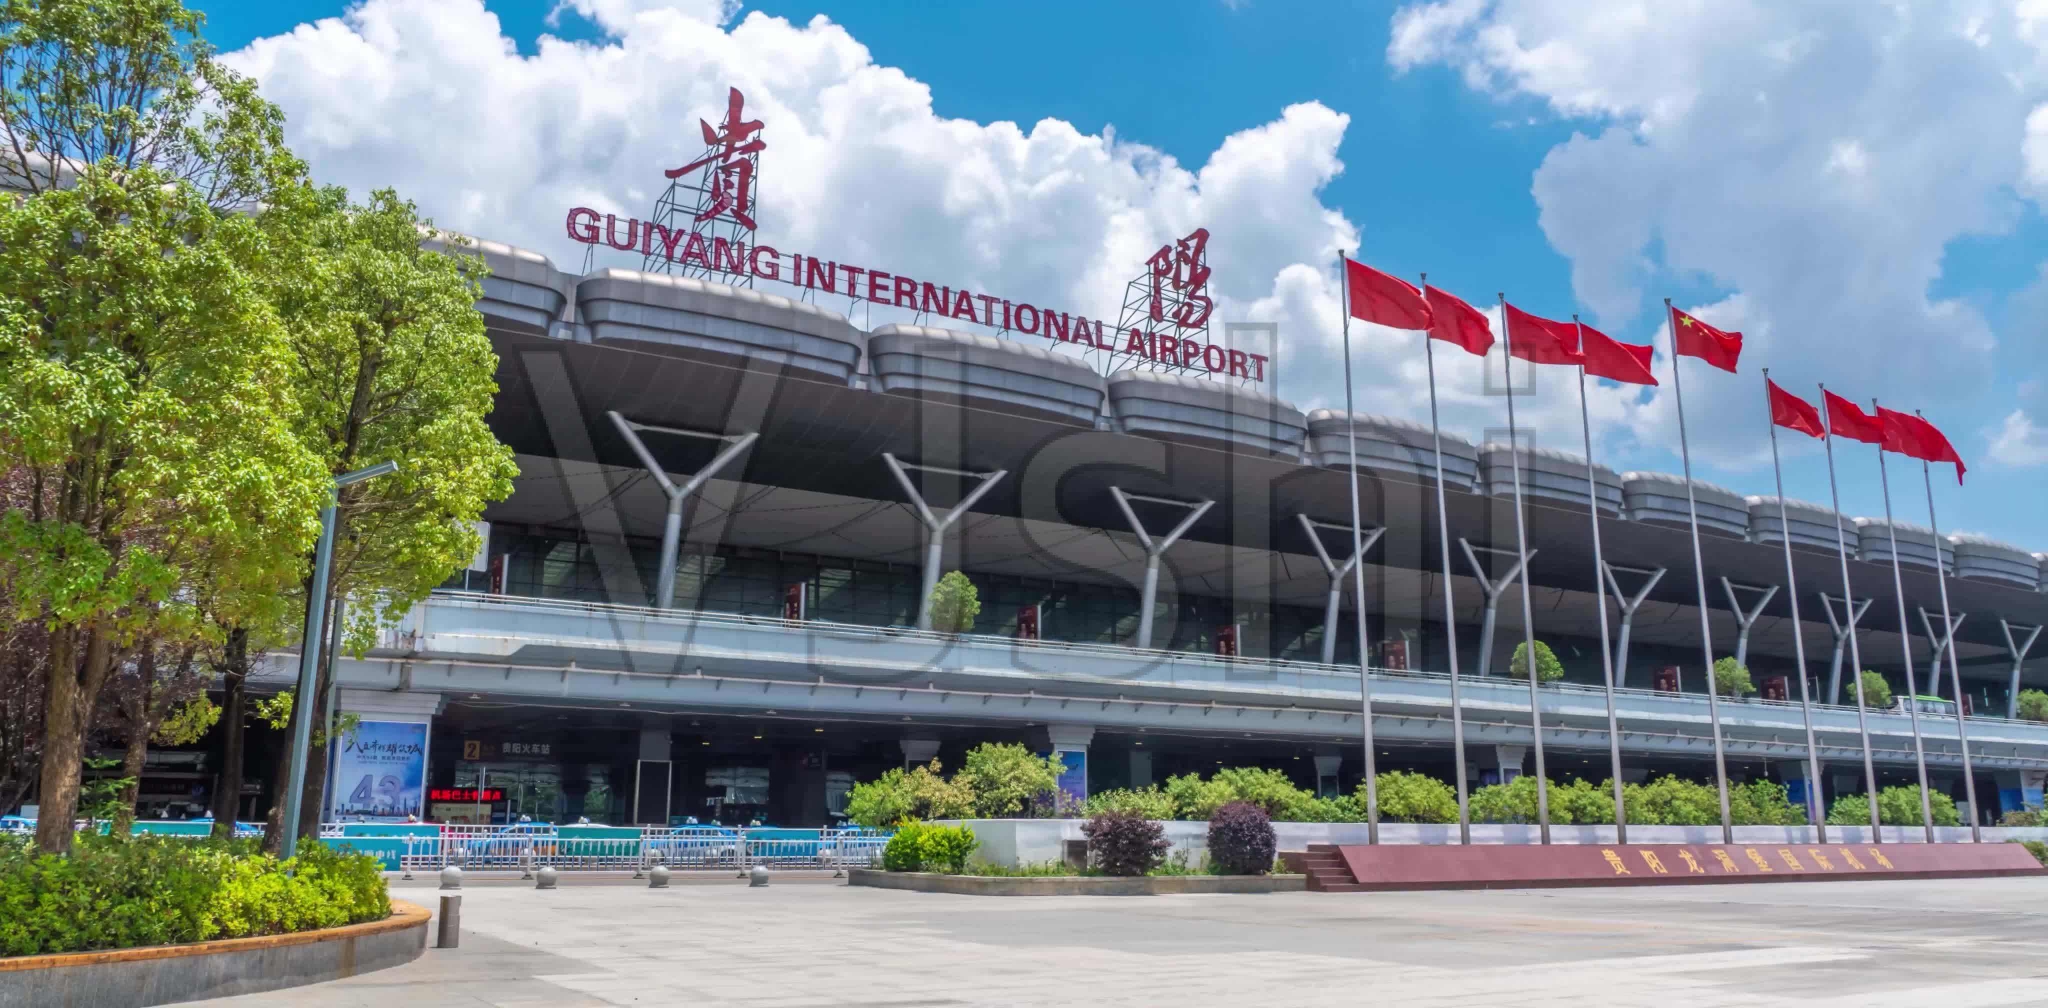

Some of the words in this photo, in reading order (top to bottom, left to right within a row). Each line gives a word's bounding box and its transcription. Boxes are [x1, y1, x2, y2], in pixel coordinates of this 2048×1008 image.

[567, 207, 780, 280] GUIYANG
[793, 253, 1114, 351] INTERNATIONAL
[1127, 327, 1269, 382] AIRPORT
[502, 742, 551, 755] 贵阳火车站
